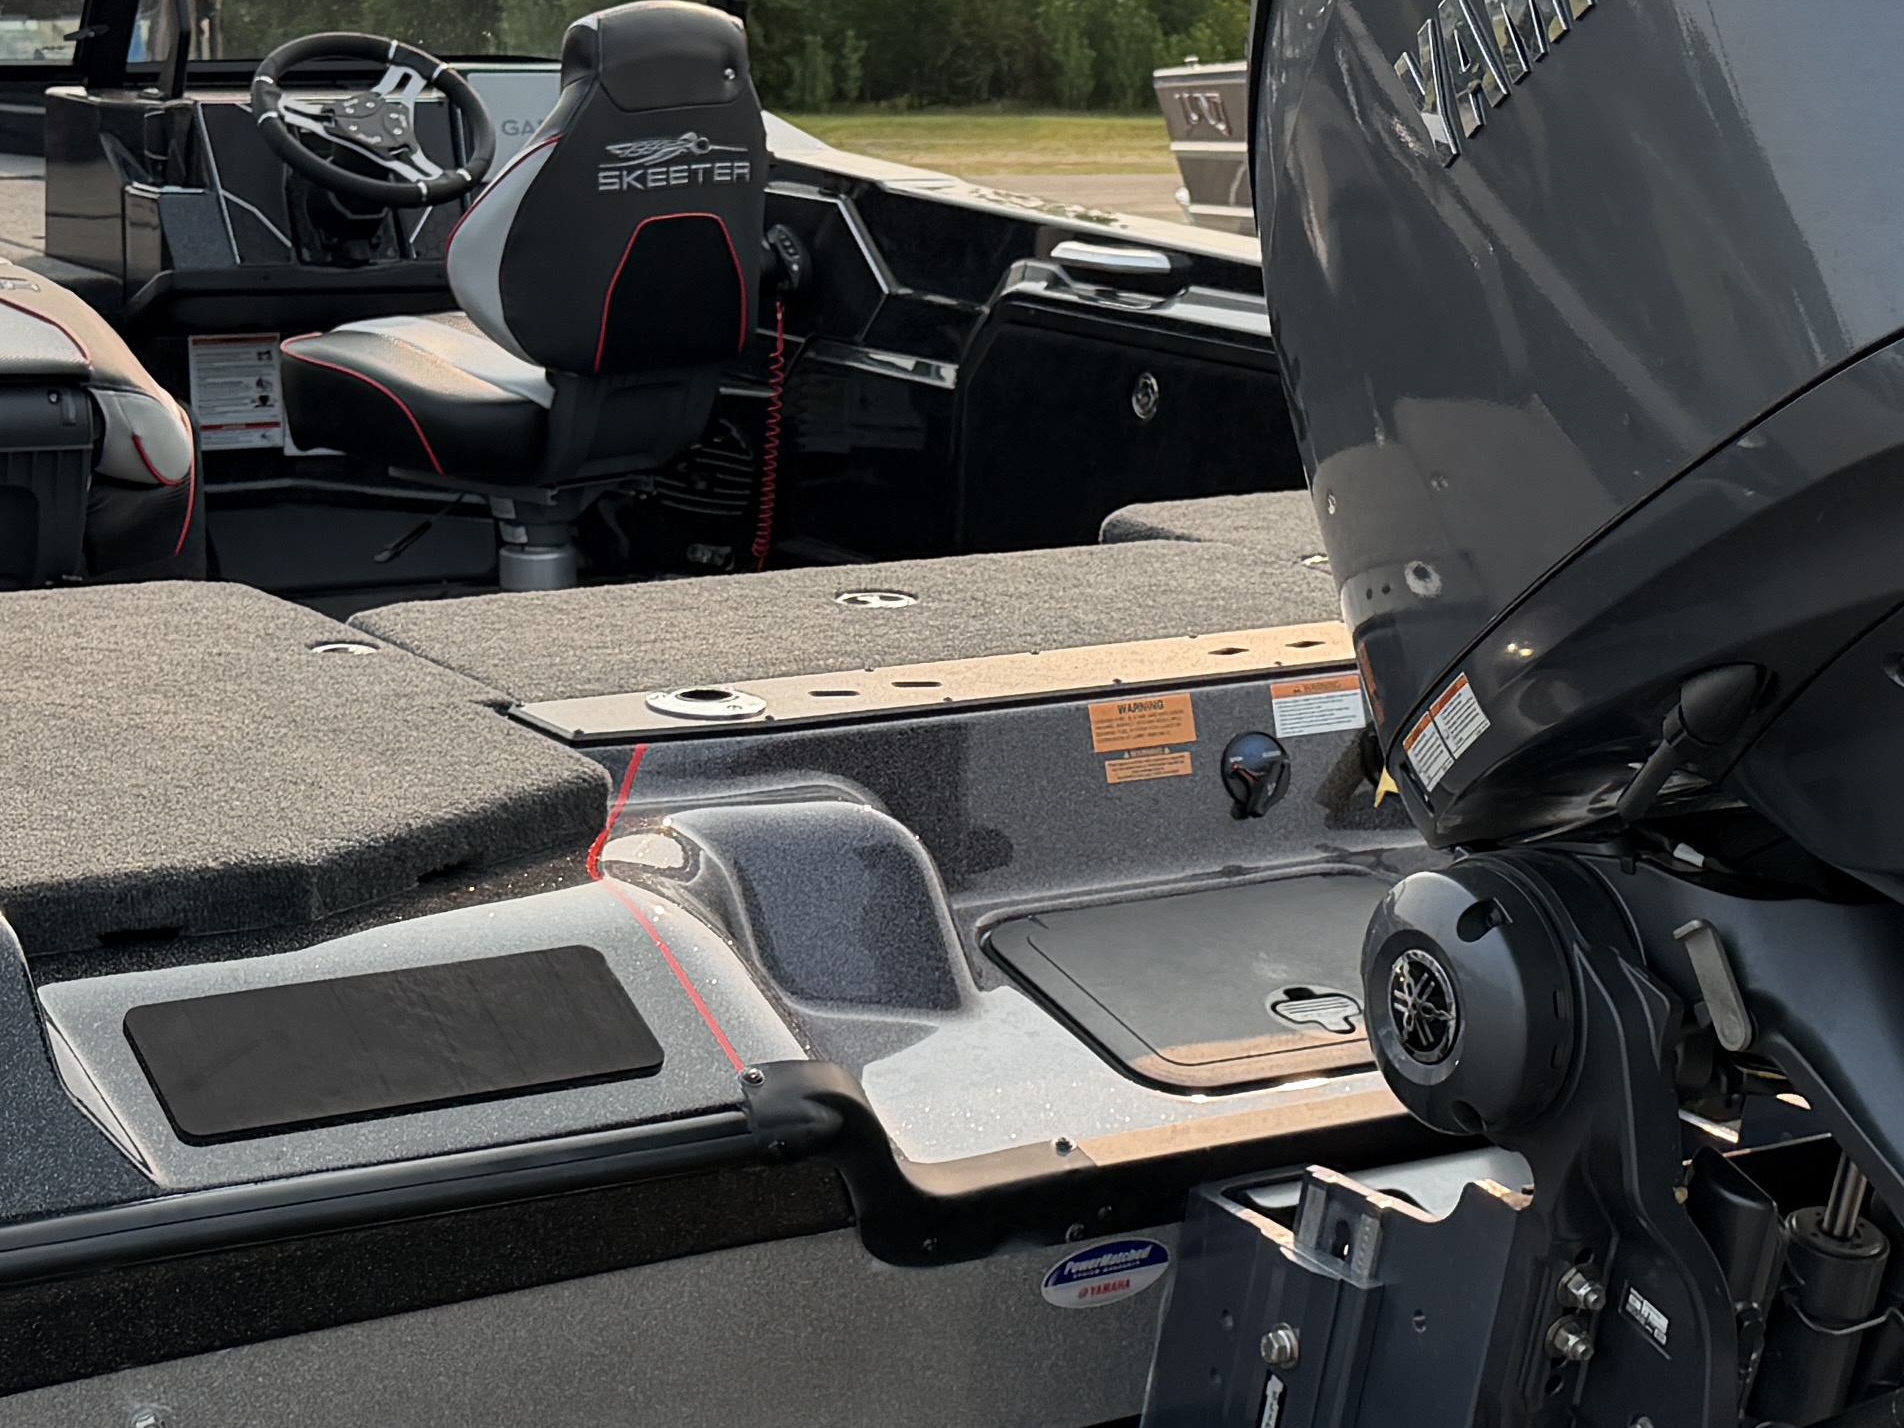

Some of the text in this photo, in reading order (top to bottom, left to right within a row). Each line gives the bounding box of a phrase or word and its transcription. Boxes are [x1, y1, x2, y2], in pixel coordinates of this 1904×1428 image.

[501, 119, 544, 136] GA
[598, 162, 751, 191] SKEETER
[1090, 1278, 1131, 1297] YAMAHA
